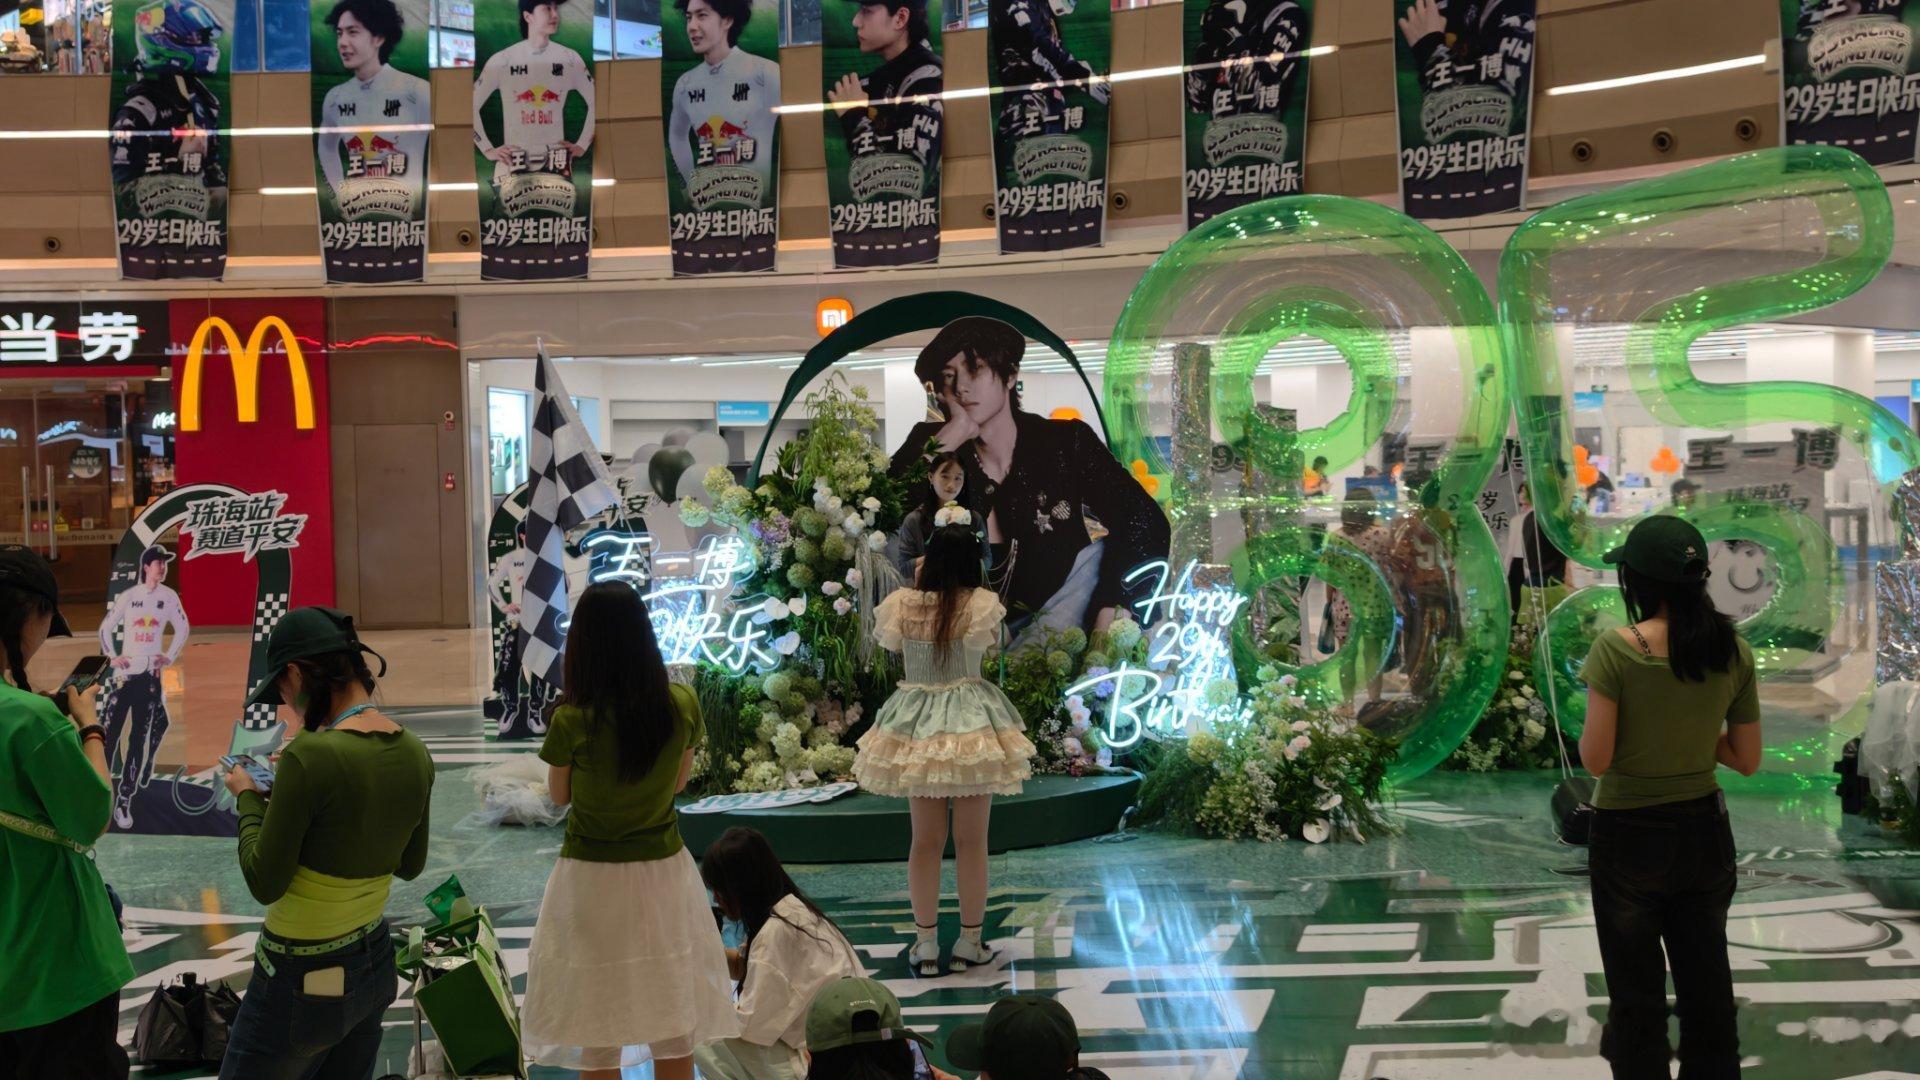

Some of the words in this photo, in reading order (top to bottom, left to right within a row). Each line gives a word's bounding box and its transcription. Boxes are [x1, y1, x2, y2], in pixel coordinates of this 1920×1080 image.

[1500, 37, 1531, 64] HH
[510, 64, 528, 76] HH
[1432, 53, 1502, 88] 王一博
[1785, 73, 1920, 123] 29岁生日快乐
[912, 114, 939, 137] HH
[1023, 106, 1084, 135] 王一博
[697, 139, 755, 164] 王一博
[857, 128, 916, 154] 王一博
[1402, 133, 1525, 180] 29岁生日快乐
[145, 152, 202, 173] 王一博
[347, 153, 408, 176] 王一博
[510, 149, 568, 171] 王一博
[1186, 160, 1299, 200] 29岁生日快乐
[998, 178, 1104, 217] 29岁生日快乐
[483, 216, 588, 248] 29岁生日快乐
[672, 207, 775, 242] 29岁生日快乐
[832, 197, 936, 233] 29岁生日快乐
[119, 218, 221, 249] 29岁生日快乐
[323, 220, 425, 251] 29岁生日快乐
[0, 312, 139, 362] 当劳
[1687, 427, 1840, 472] 王一博
[188, 494, 277, 528] 珠海站
[197, 518, 300, 552] 赛道平安
[587, 535, 750, 589] 王一博
[1125, 558, 1248, 626] Happy
